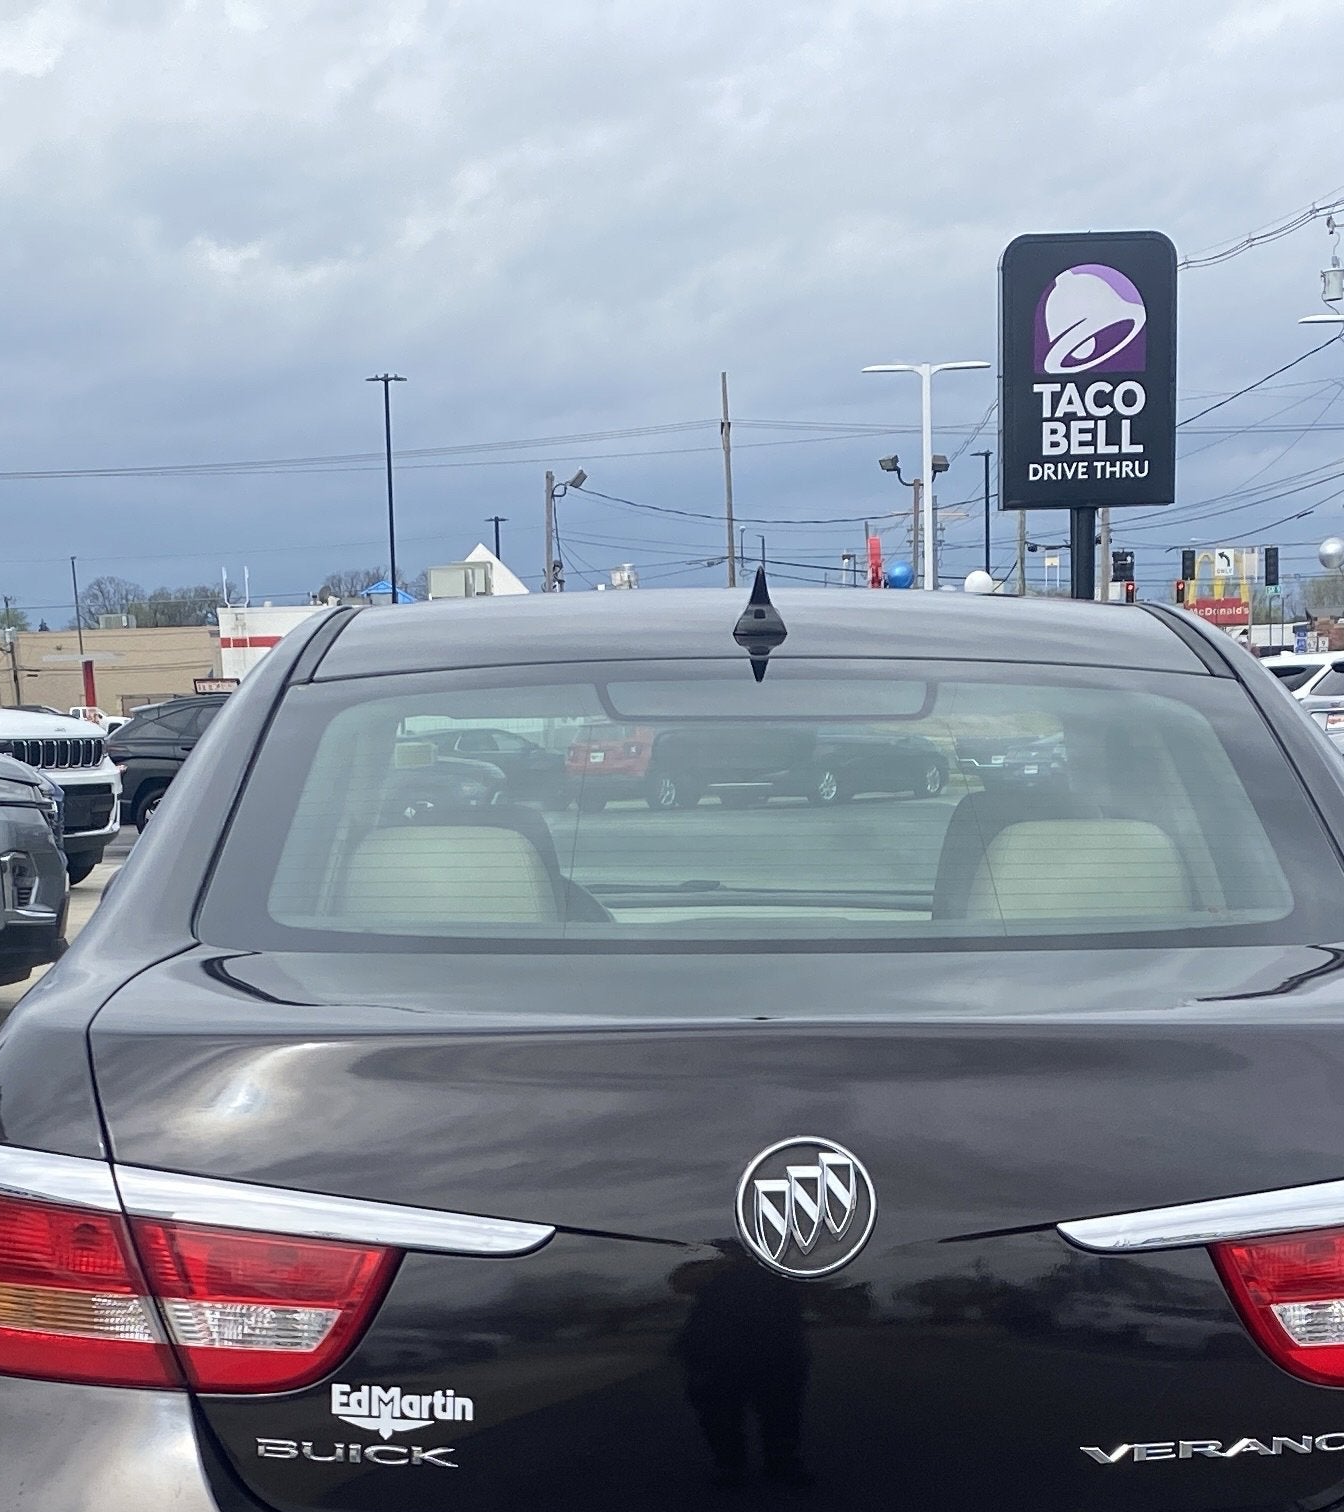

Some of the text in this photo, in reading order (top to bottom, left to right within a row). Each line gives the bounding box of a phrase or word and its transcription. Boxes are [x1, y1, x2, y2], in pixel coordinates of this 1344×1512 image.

[1033, 380, 1146, 418] TACO
[1042, 419, 1144, 456] BELL
[1028, 460, 1149, 481] DRIVE THRU
[1190, 606, 1249, 616] McDonald's
[331, 1383, 474, 1421] EdMartin
[256, 1437, 459, 1468] BUICK
